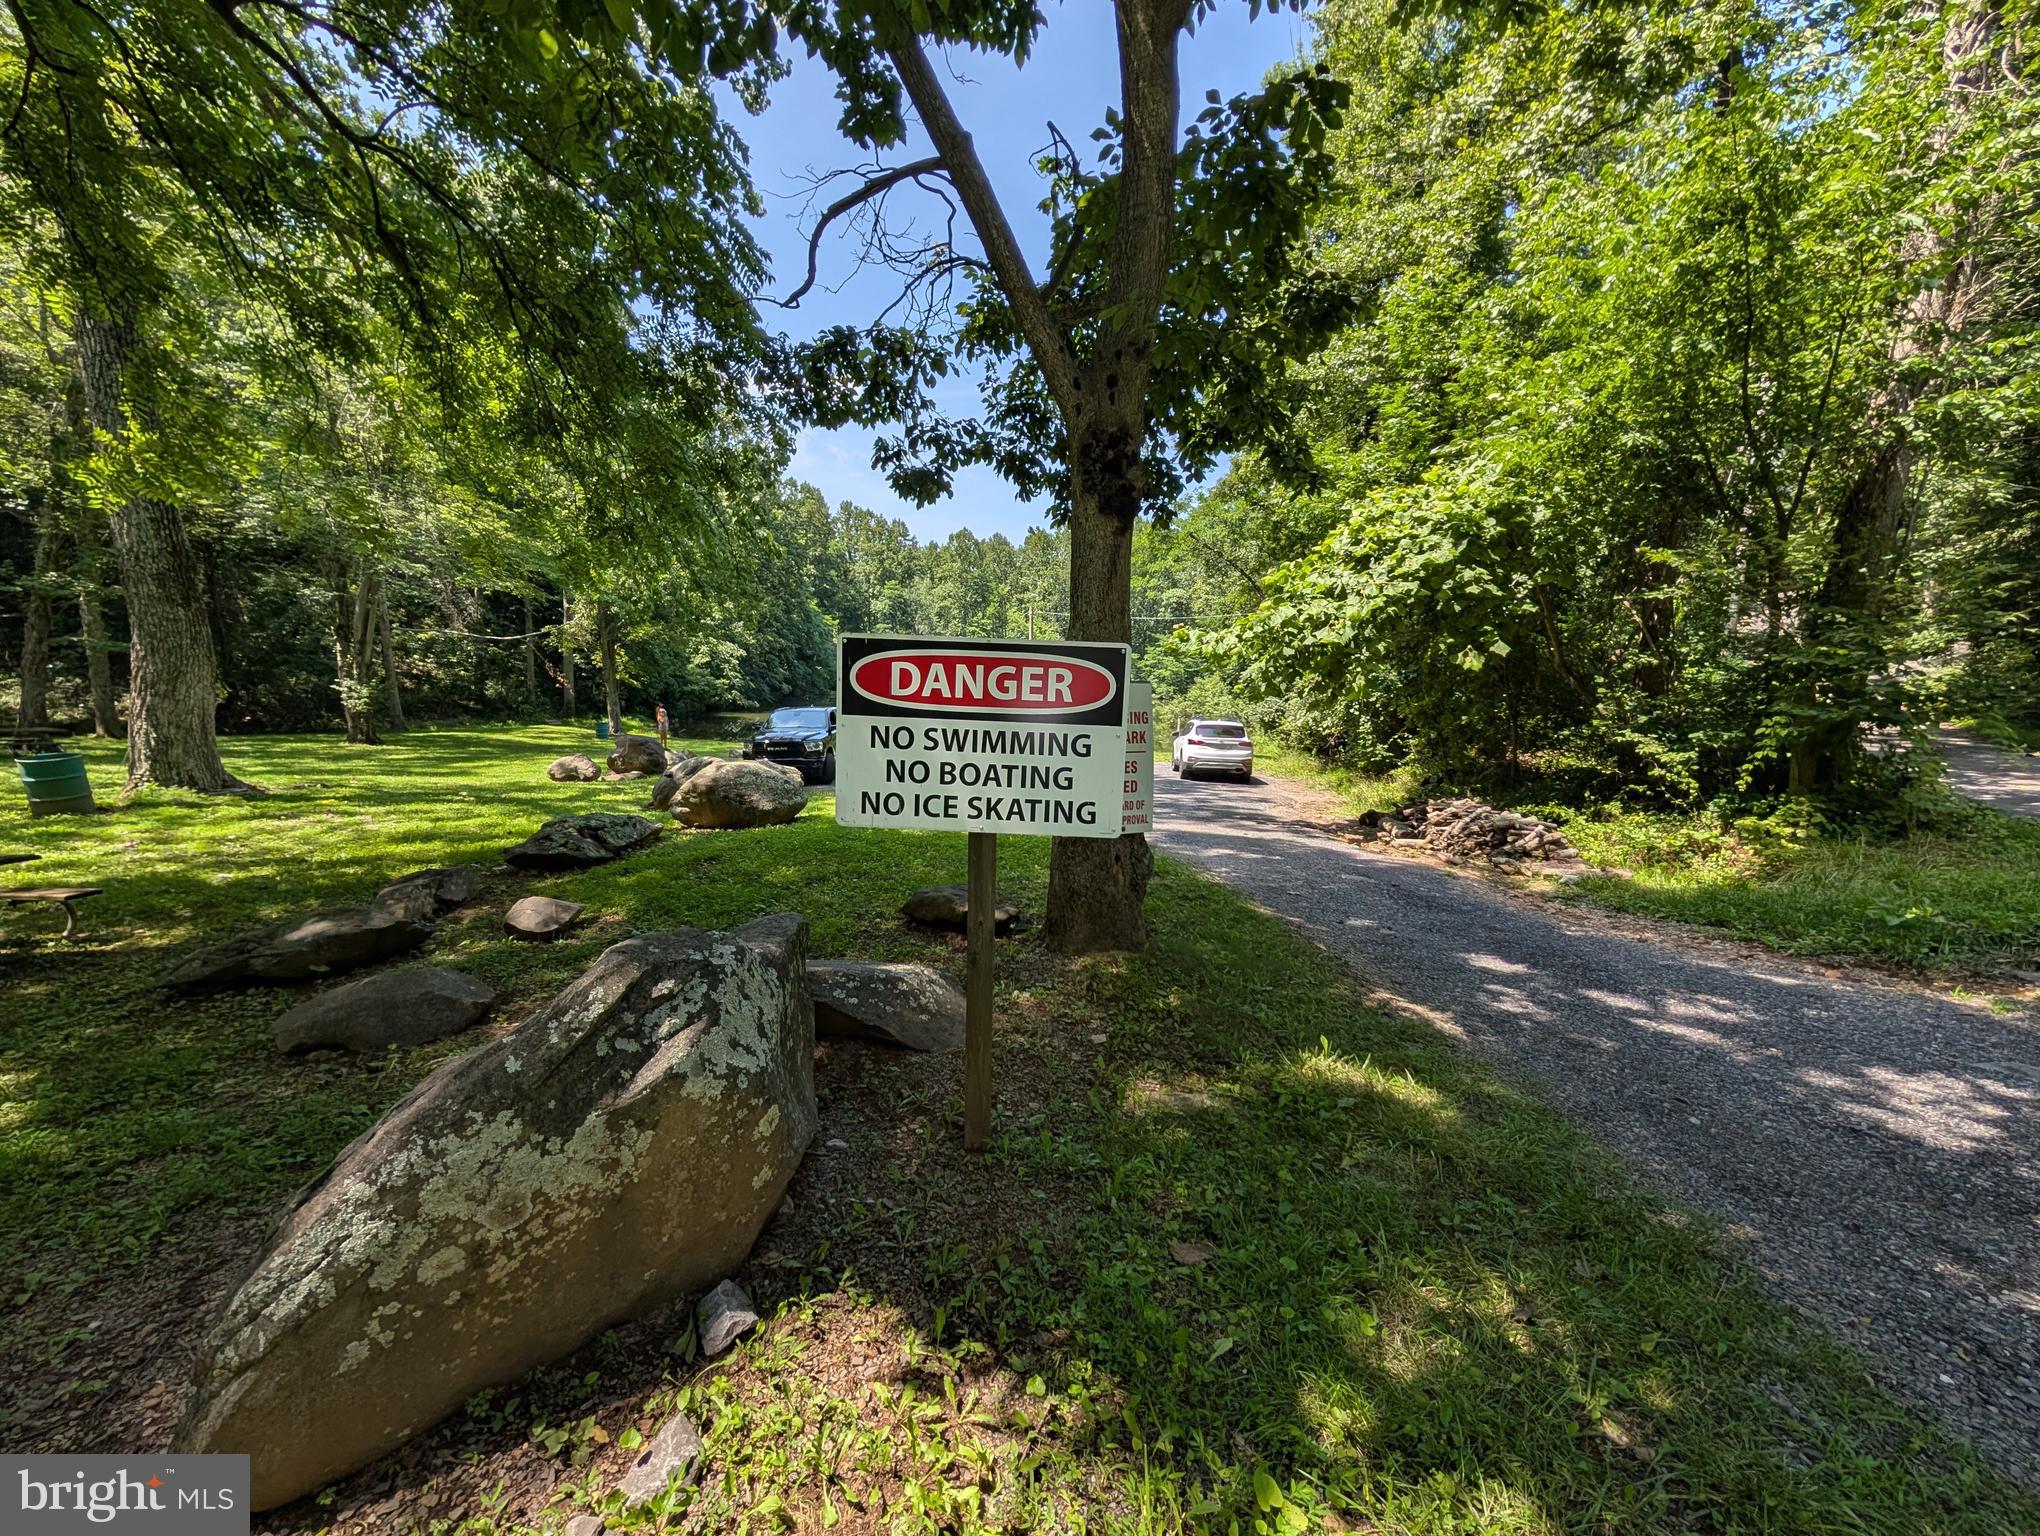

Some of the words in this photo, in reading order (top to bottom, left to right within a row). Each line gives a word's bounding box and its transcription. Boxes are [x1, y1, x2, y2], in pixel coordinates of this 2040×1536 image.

[890, 661, 1073, 703] DANGER
[1127, 711, 1149, 725] ING
[870, 725, 915, 750] NO
[923, 727, 1092, 758] SWIMMING
[886, 759, 931, 785] NO
[940, 761, 1074, 791] BOATING
[861, 791, 905, 816] NO
[914, 794, 958, 819] ICE
[967, 796, 1097, 825] SKATING
[1135, 799, 1145, 810] OF
